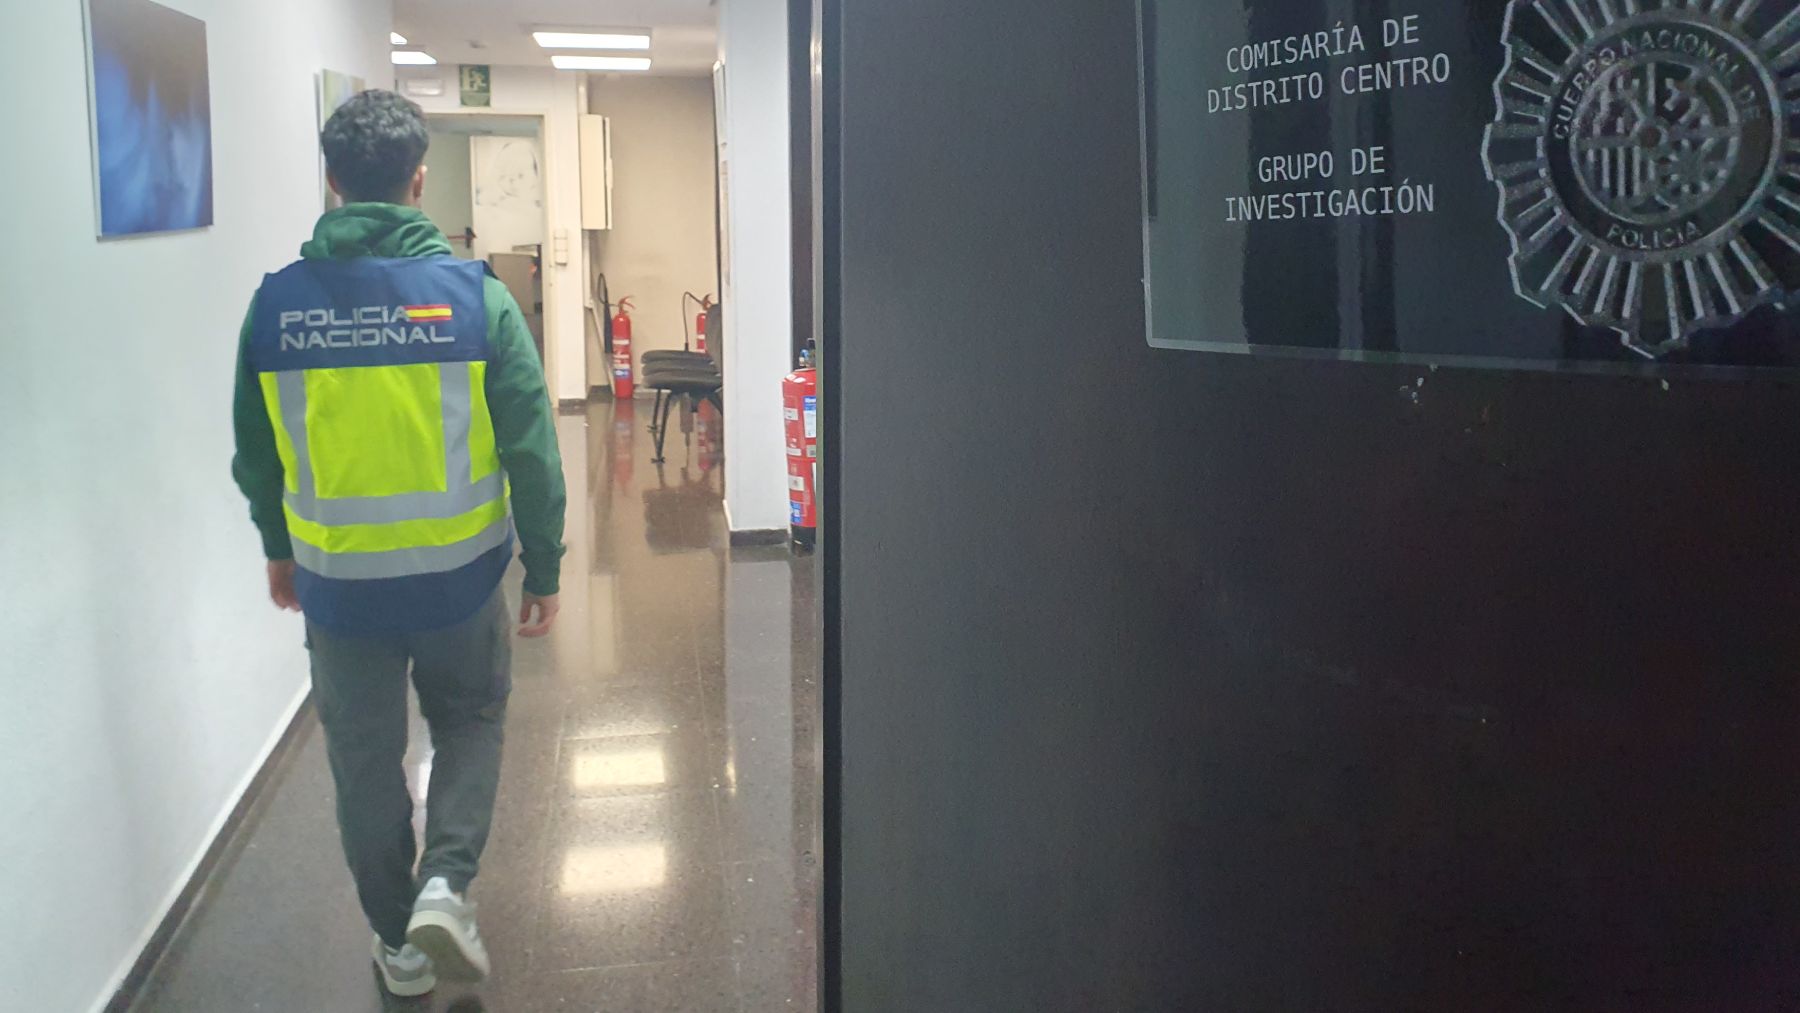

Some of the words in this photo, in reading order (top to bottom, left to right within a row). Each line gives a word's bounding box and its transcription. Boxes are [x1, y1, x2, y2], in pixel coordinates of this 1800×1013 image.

[1226, 20, 1365, 73] COMISARÍA
[1383, 14, 1420, 48] DE
[1207, 72, 1324, 114] DISTRITO
[1340, 52, 1451, 95] CENTRO
[1553, 47, 1616, 140] CUERPO
[1258, 150, 1334, 183] GRUPO
[1351, 146, 1386, 175] DE
[1225, 177, 1435, 221] INVESTIGACIÓN
[280, 325, 456, 351] NACIONAL
